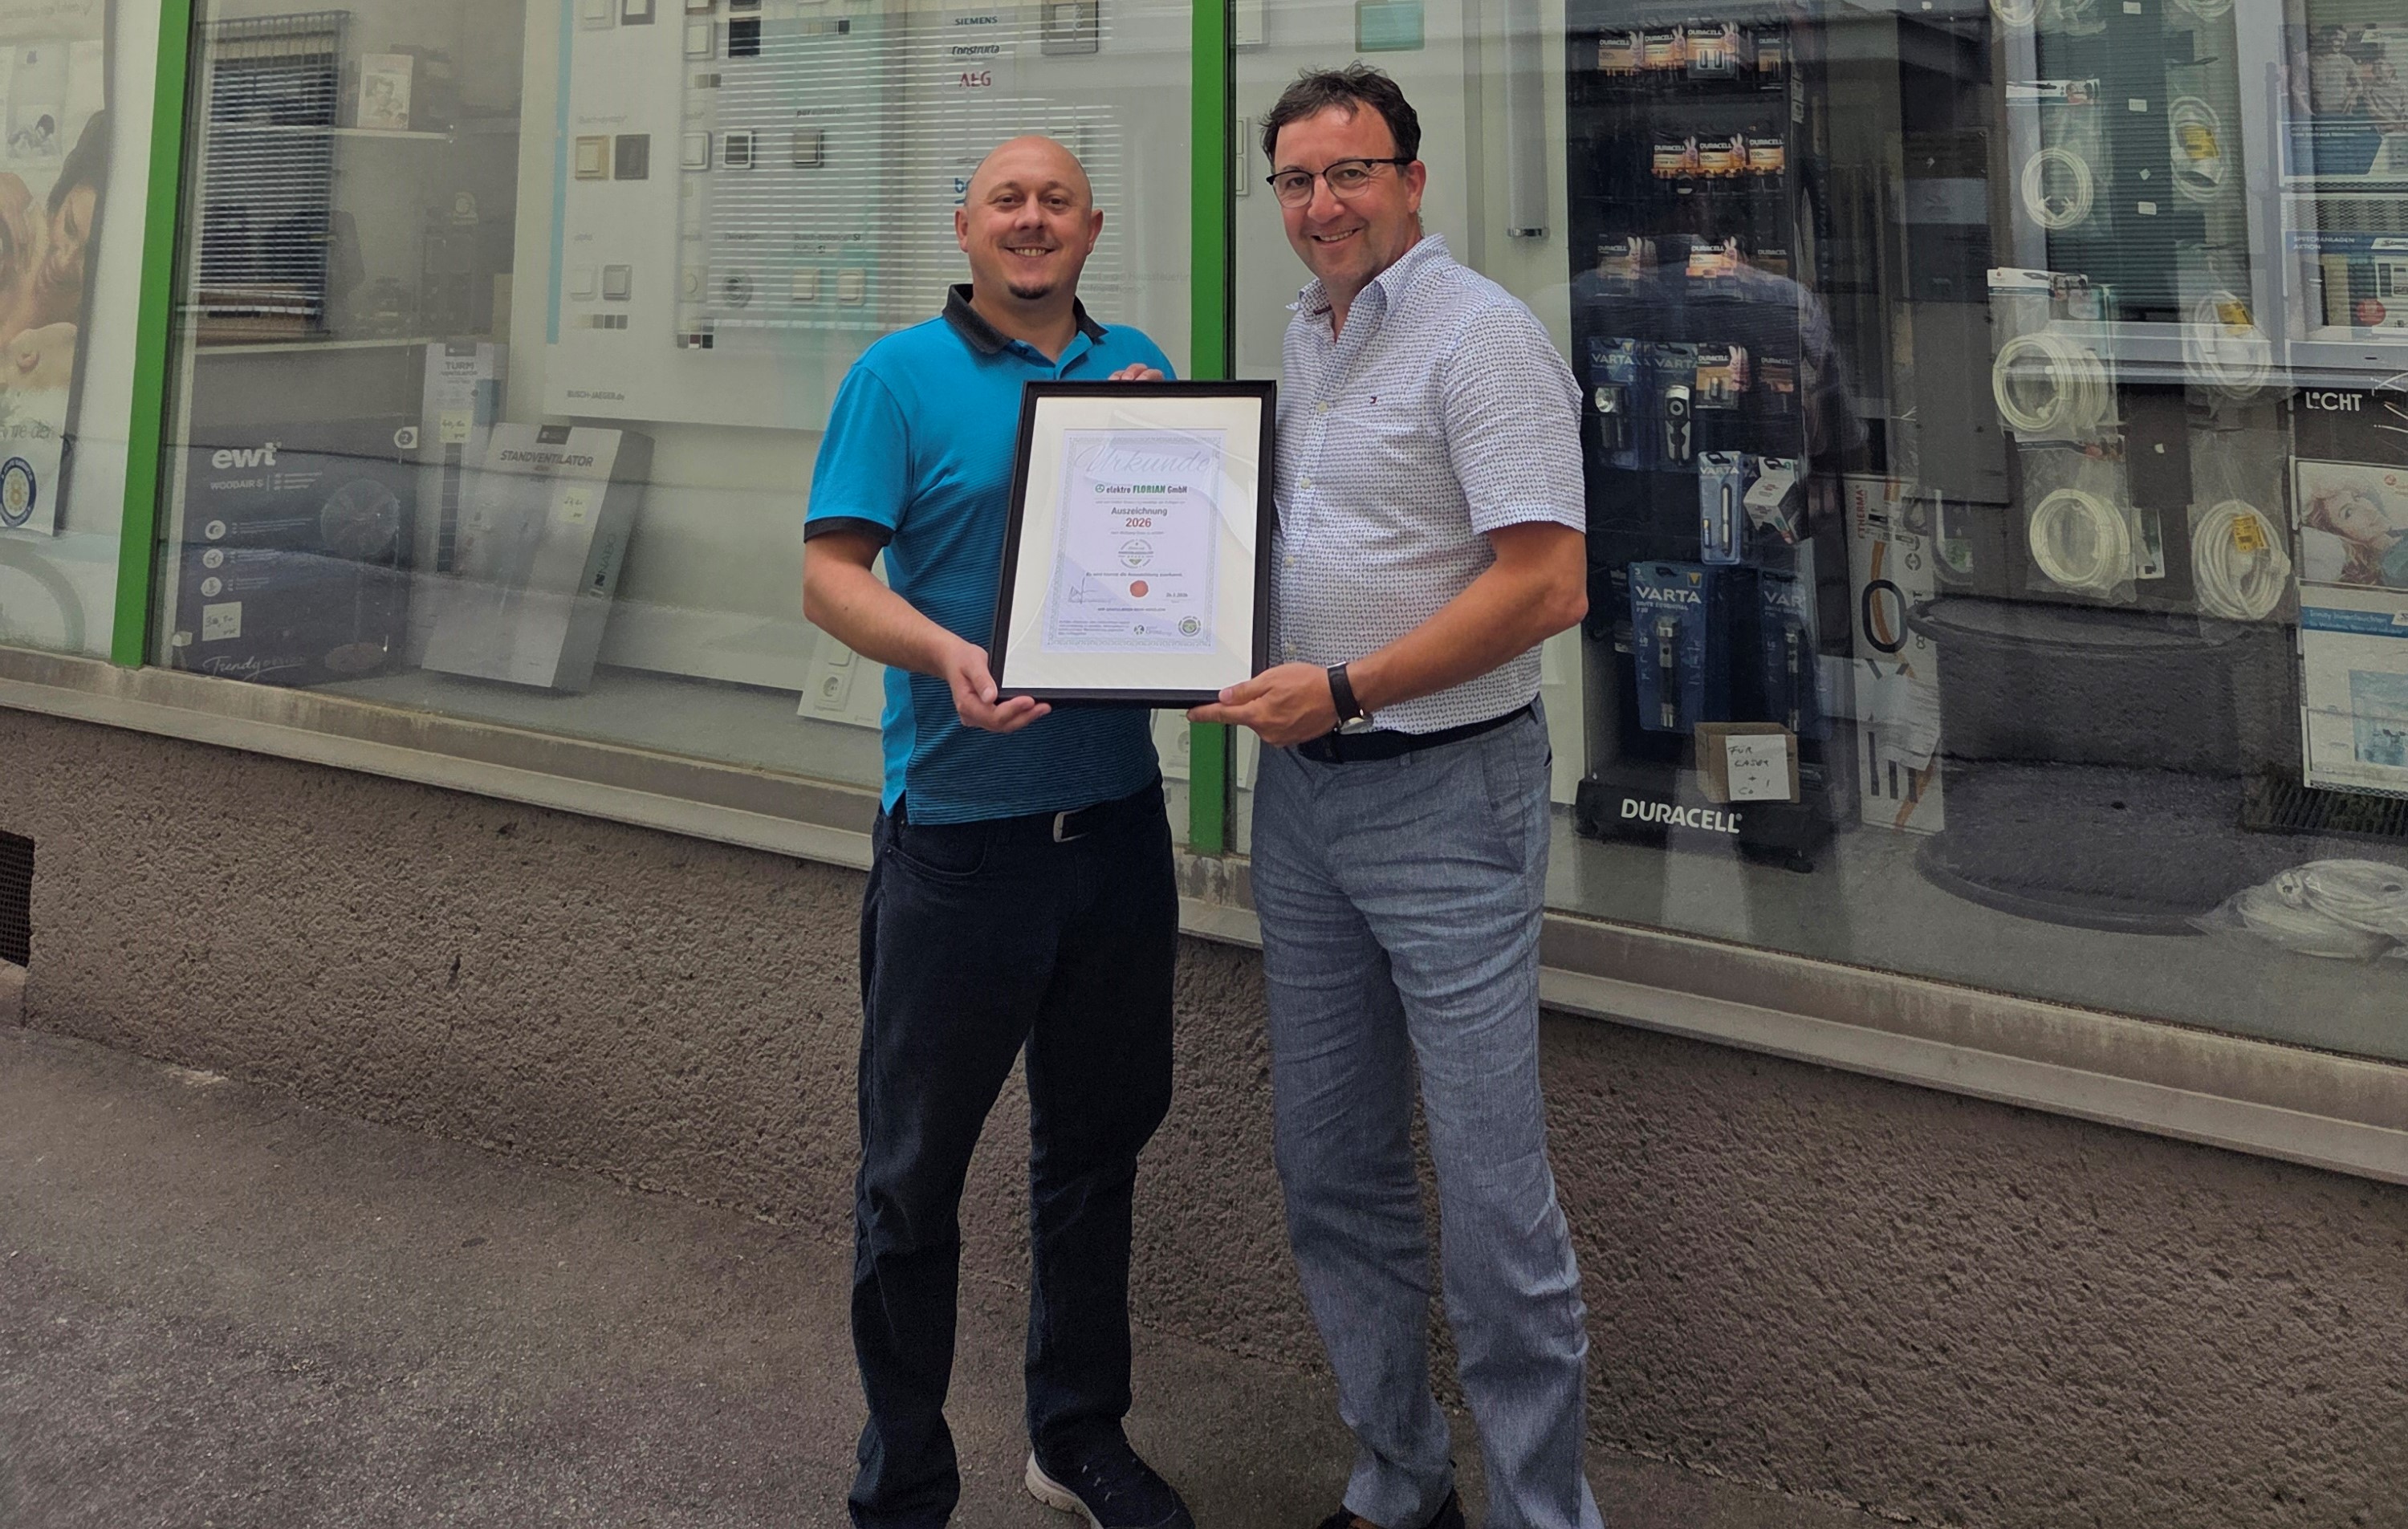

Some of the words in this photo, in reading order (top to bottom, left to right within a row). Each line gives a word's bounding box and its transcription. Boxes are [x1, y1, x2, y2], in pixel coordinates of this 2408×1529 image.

[954, 16, 998, 26] SIEMENS
[959, 71, 991, 87] AEG
[1592, 353, 1635, 364] VARTA
[500, 449, 594, 467] STANDVENTILATOR
[1699, 466, 1740, 475] VARTA
[1106, 485, 1131, 494] elektro
[1133, 485, 1166, 494] FLORIAN
[1167, 485, 1188, 494] GmbH
[1111, 506, 1168, 516] Auszeichnung
[1125, 517, 1152, 527] 2026
[1635, 585, 1702, 604] VARTA
[1764, 590, 1806, 607] VAR
[1621, 798, 1740, 834] DURACELL
